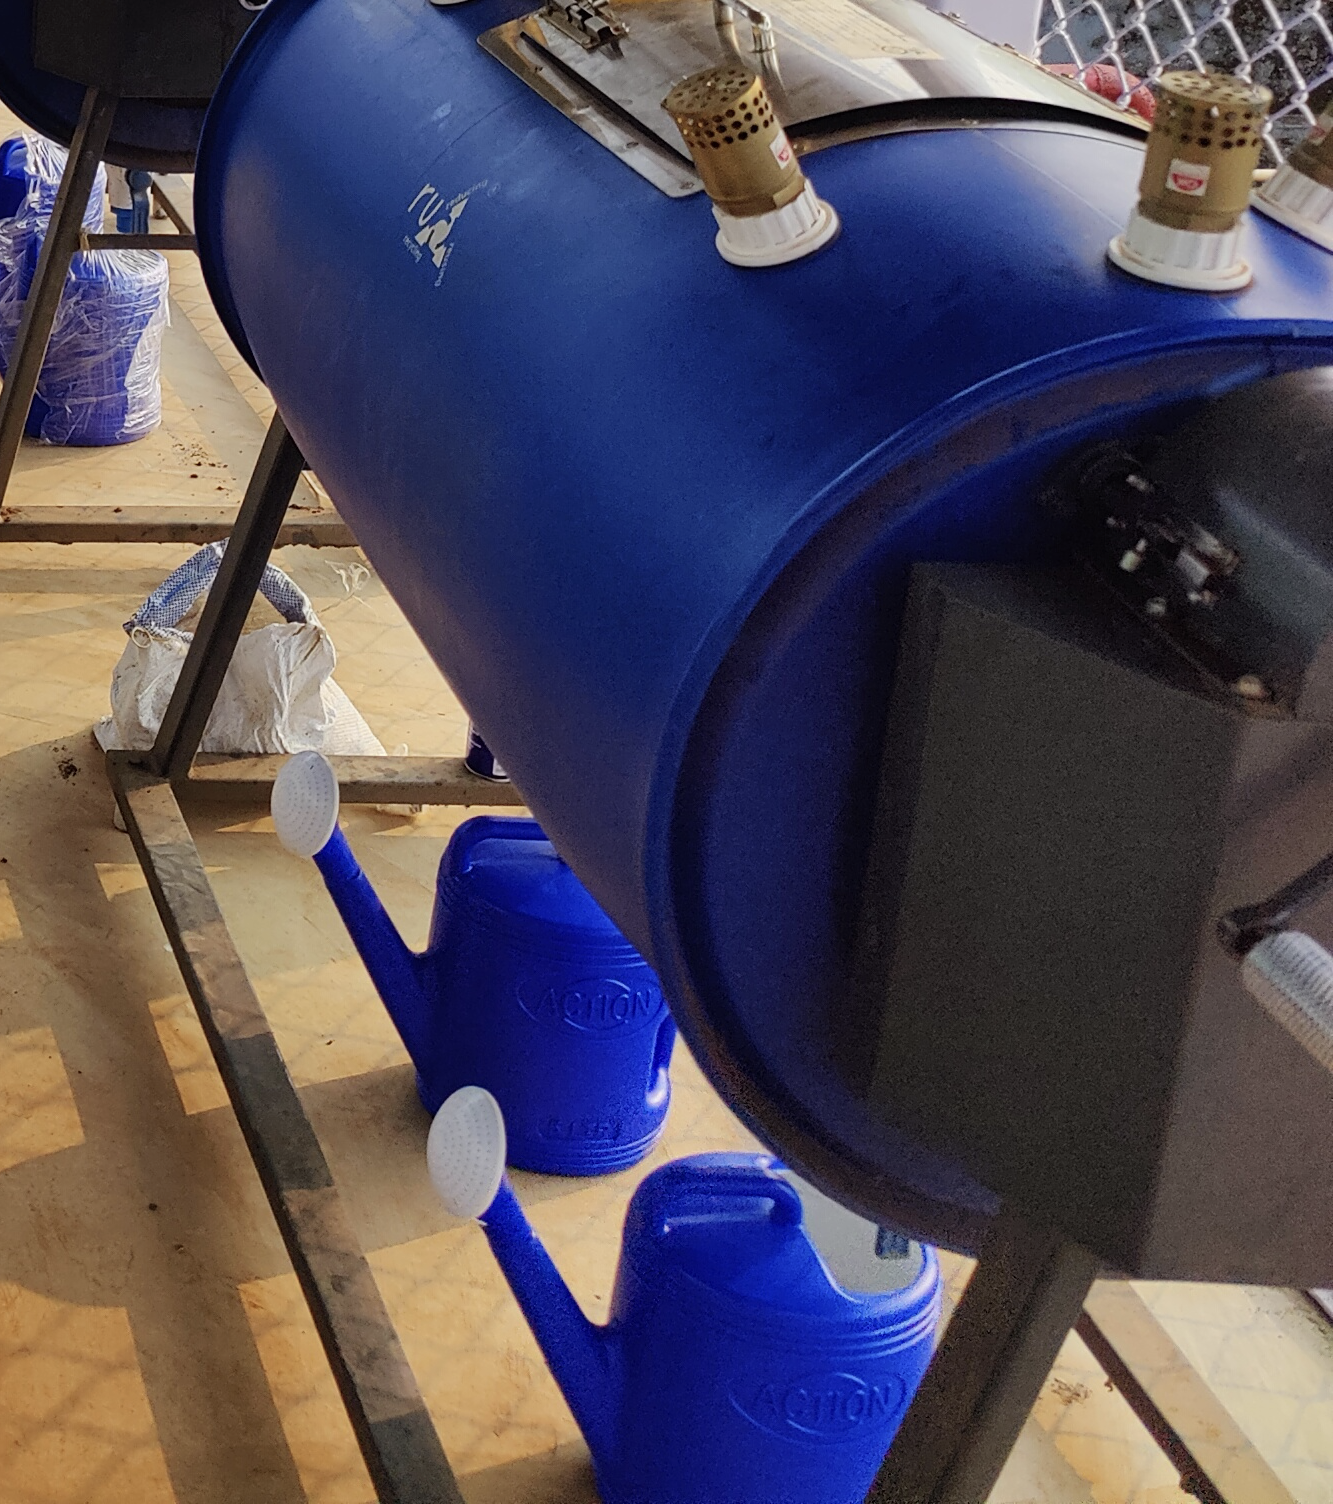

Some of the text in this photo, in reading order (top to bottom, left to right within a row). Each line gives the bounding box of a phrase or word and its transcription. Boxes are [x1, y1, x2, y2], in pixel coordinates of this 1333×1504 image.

[445, 179, 488, 210] reducing
[537, 988, 652, 1022] ACTION
[755, 1382, 894, 1424] ACTION
